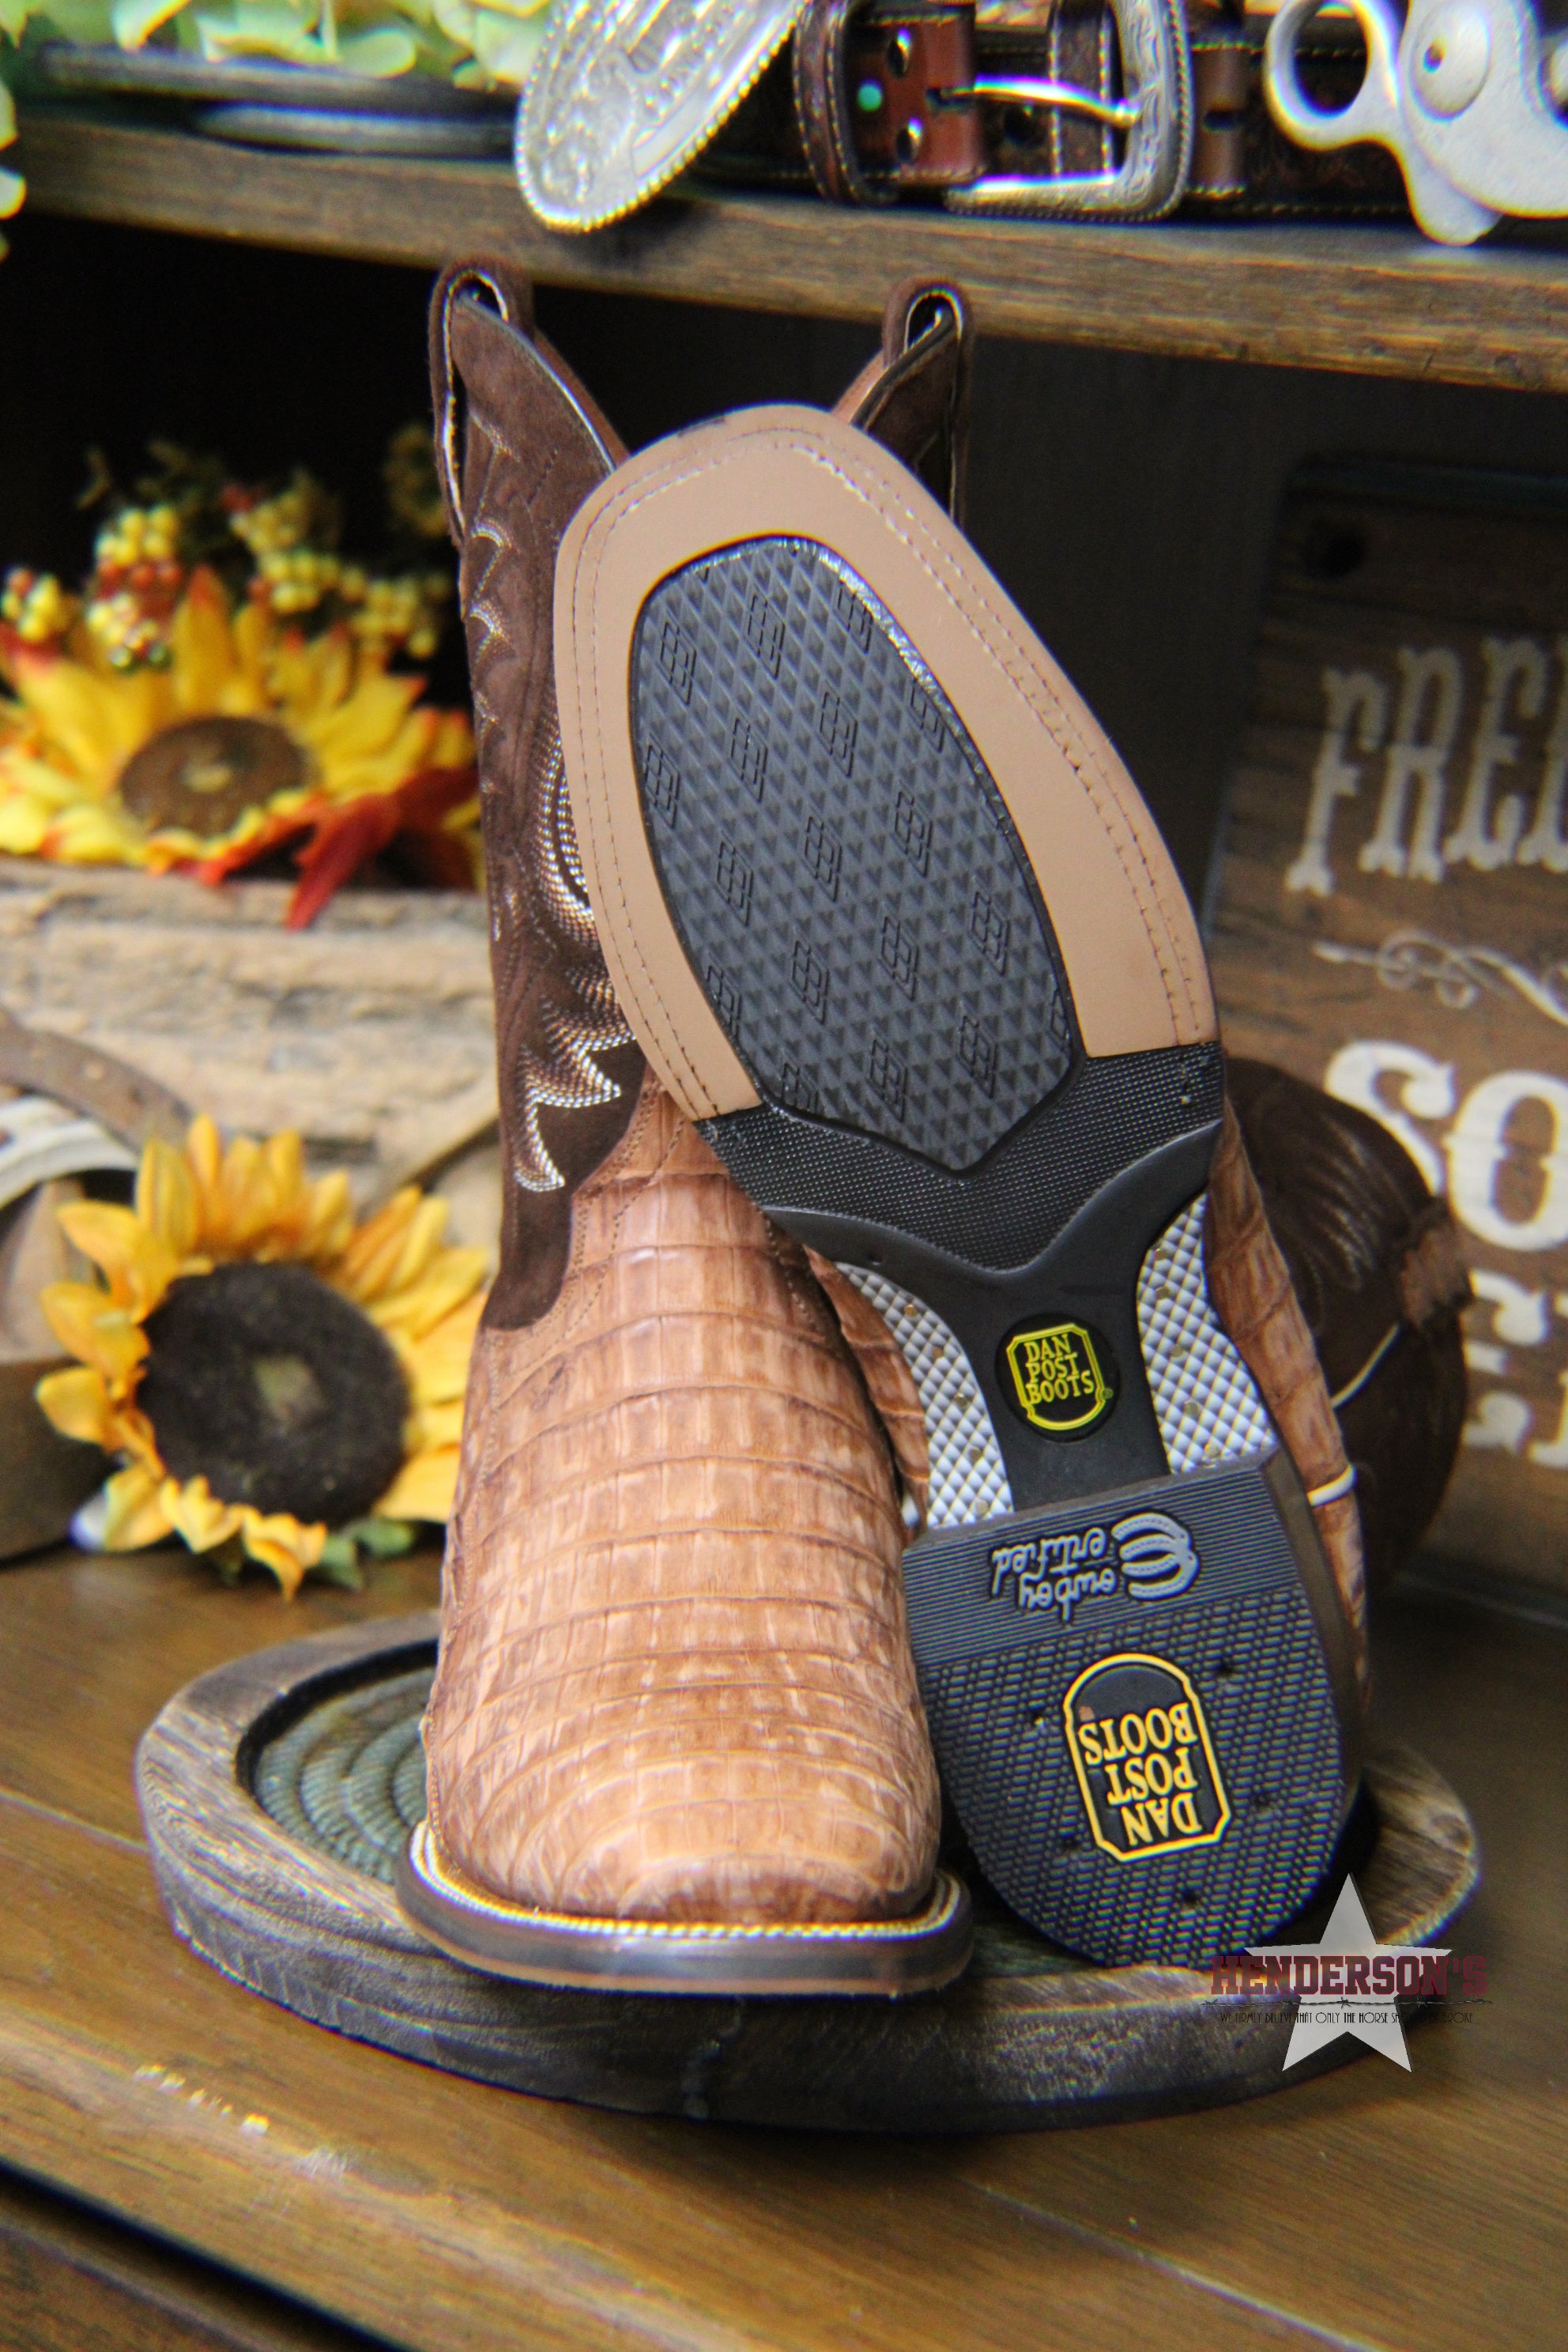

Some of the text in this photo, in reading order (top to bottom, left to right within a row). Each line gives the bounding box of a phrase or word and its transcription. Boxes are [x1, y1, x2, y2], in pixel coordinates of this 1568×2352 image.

[1024, 1333, 1071, 1363] DAN
[1025, 1352, 1080, 1383] POST
[1026, 1370, 1095, 1404] BOOTS
[1078, 1702, 1198, 1766] BOOTS
[1104, 1747, 1199, 1806] POST
[1121, 1792, 1203, 1846] DAN
